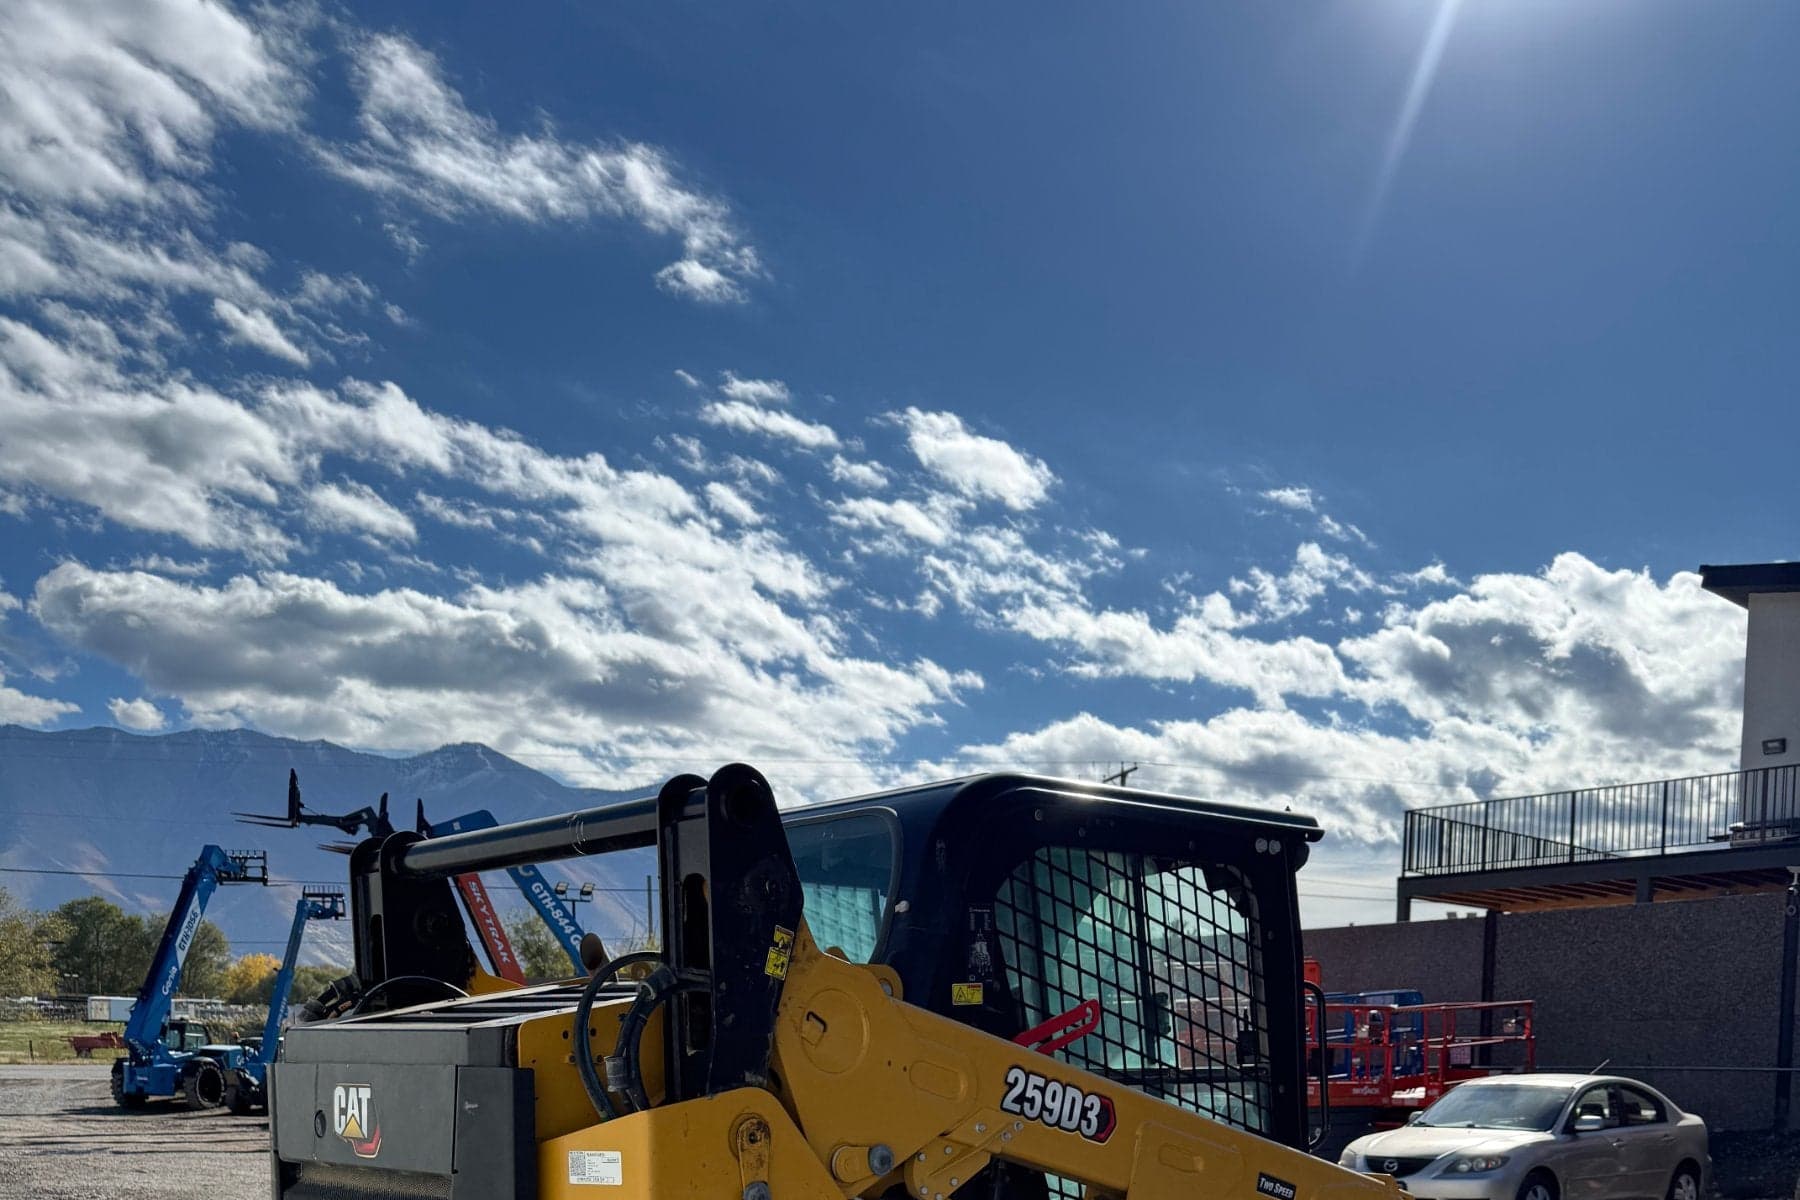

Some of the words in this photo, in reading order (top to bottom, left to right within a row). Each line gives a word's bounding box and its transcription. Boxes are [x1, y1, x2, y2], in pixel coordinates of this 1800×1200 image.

[468, 881, 511, 963] SKYTRAK
[531, 882, 576, 934] GTH-844
[334, 1086, 371, 1138] CAT
[1002, 1067, 1101, 1137] 259D3
